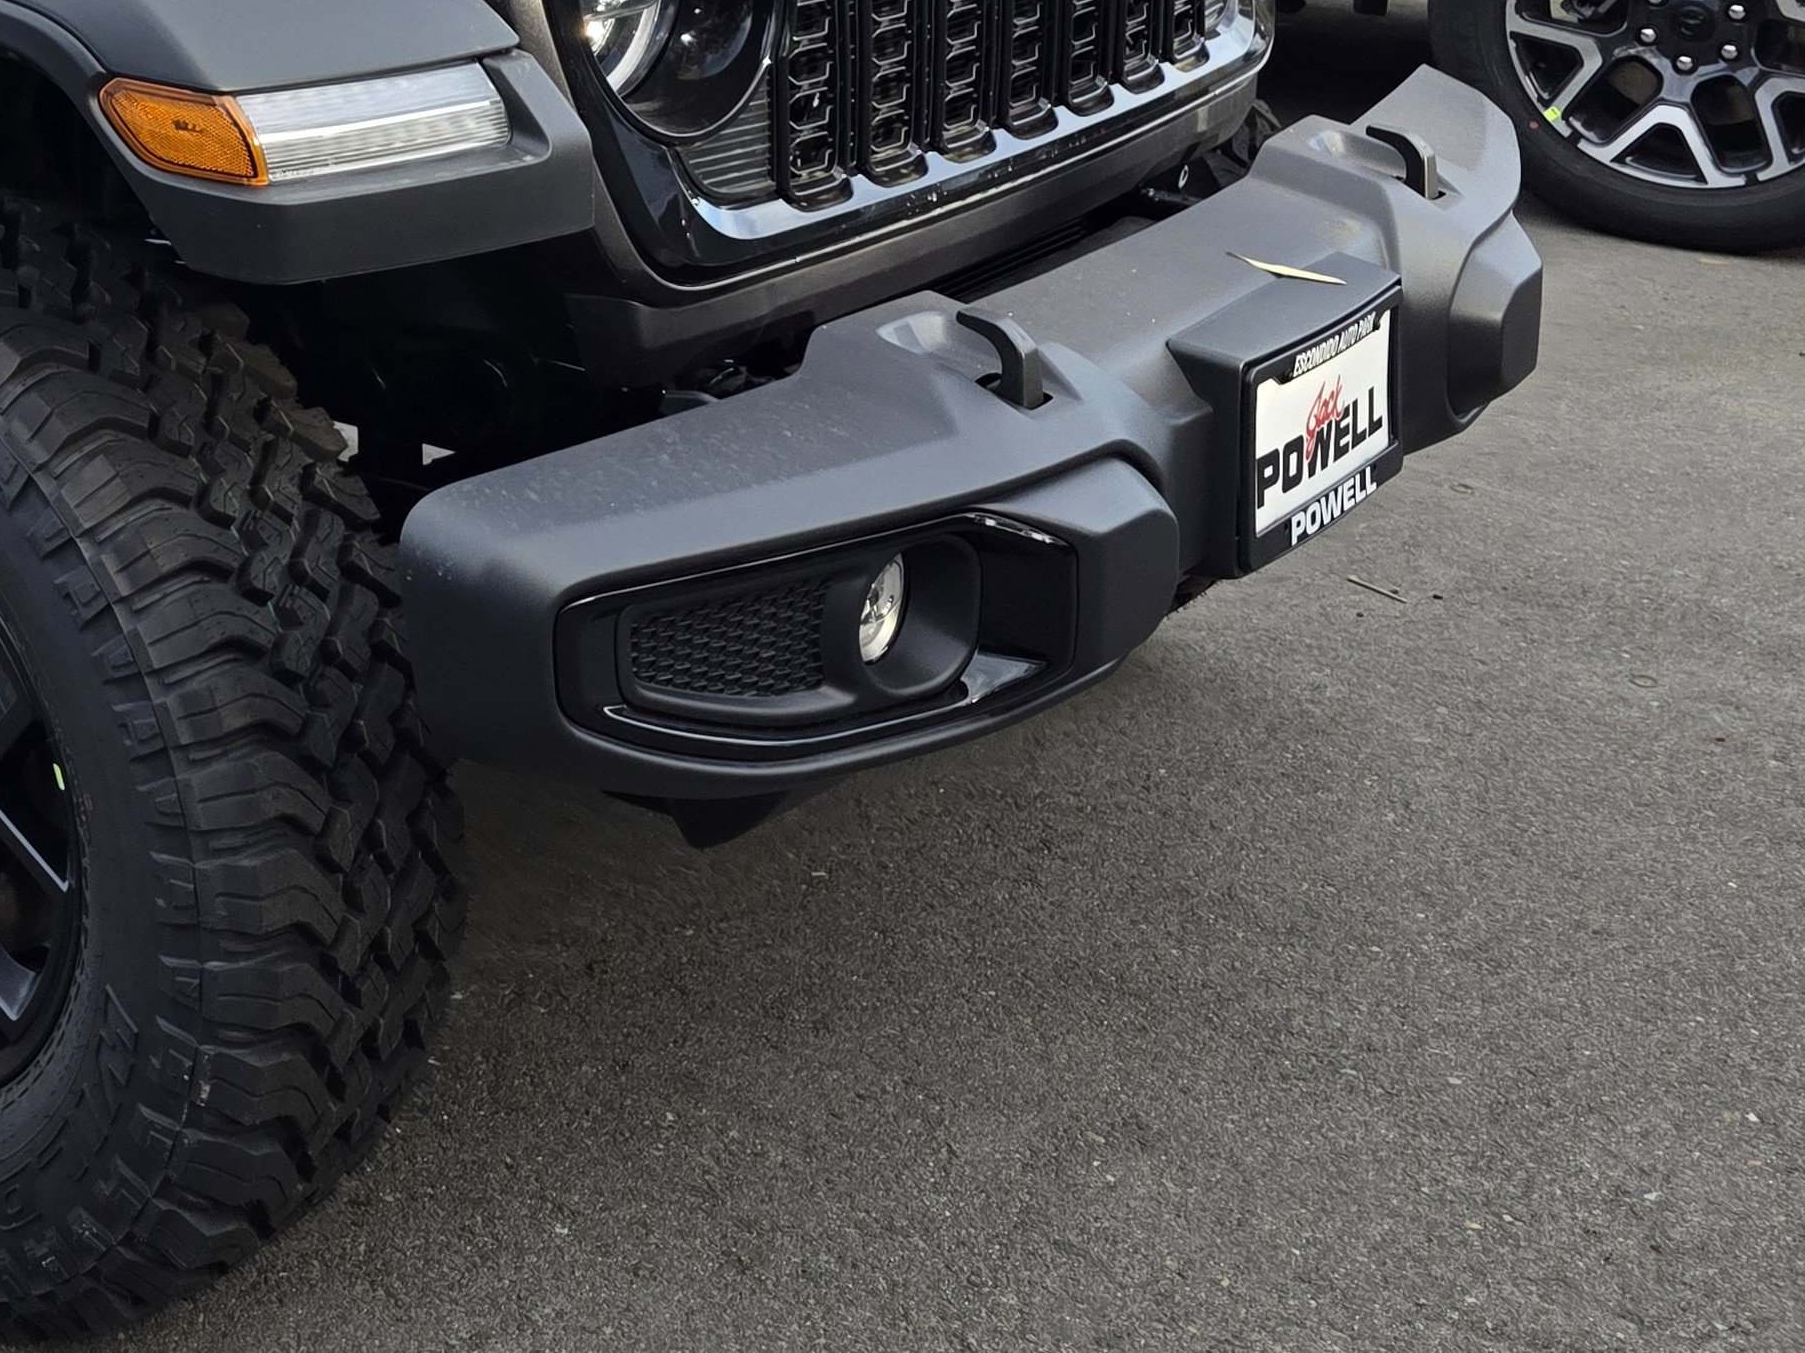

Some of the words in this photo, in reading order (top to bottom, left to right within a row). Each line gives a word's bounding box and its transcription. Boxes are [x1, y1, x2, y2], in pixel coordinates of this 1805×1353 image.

[1257, 386, 1383, 510] POWELL
[1306, 374, 1346, 461] Jack
[1291, 465, 1378, 547] POWELL
